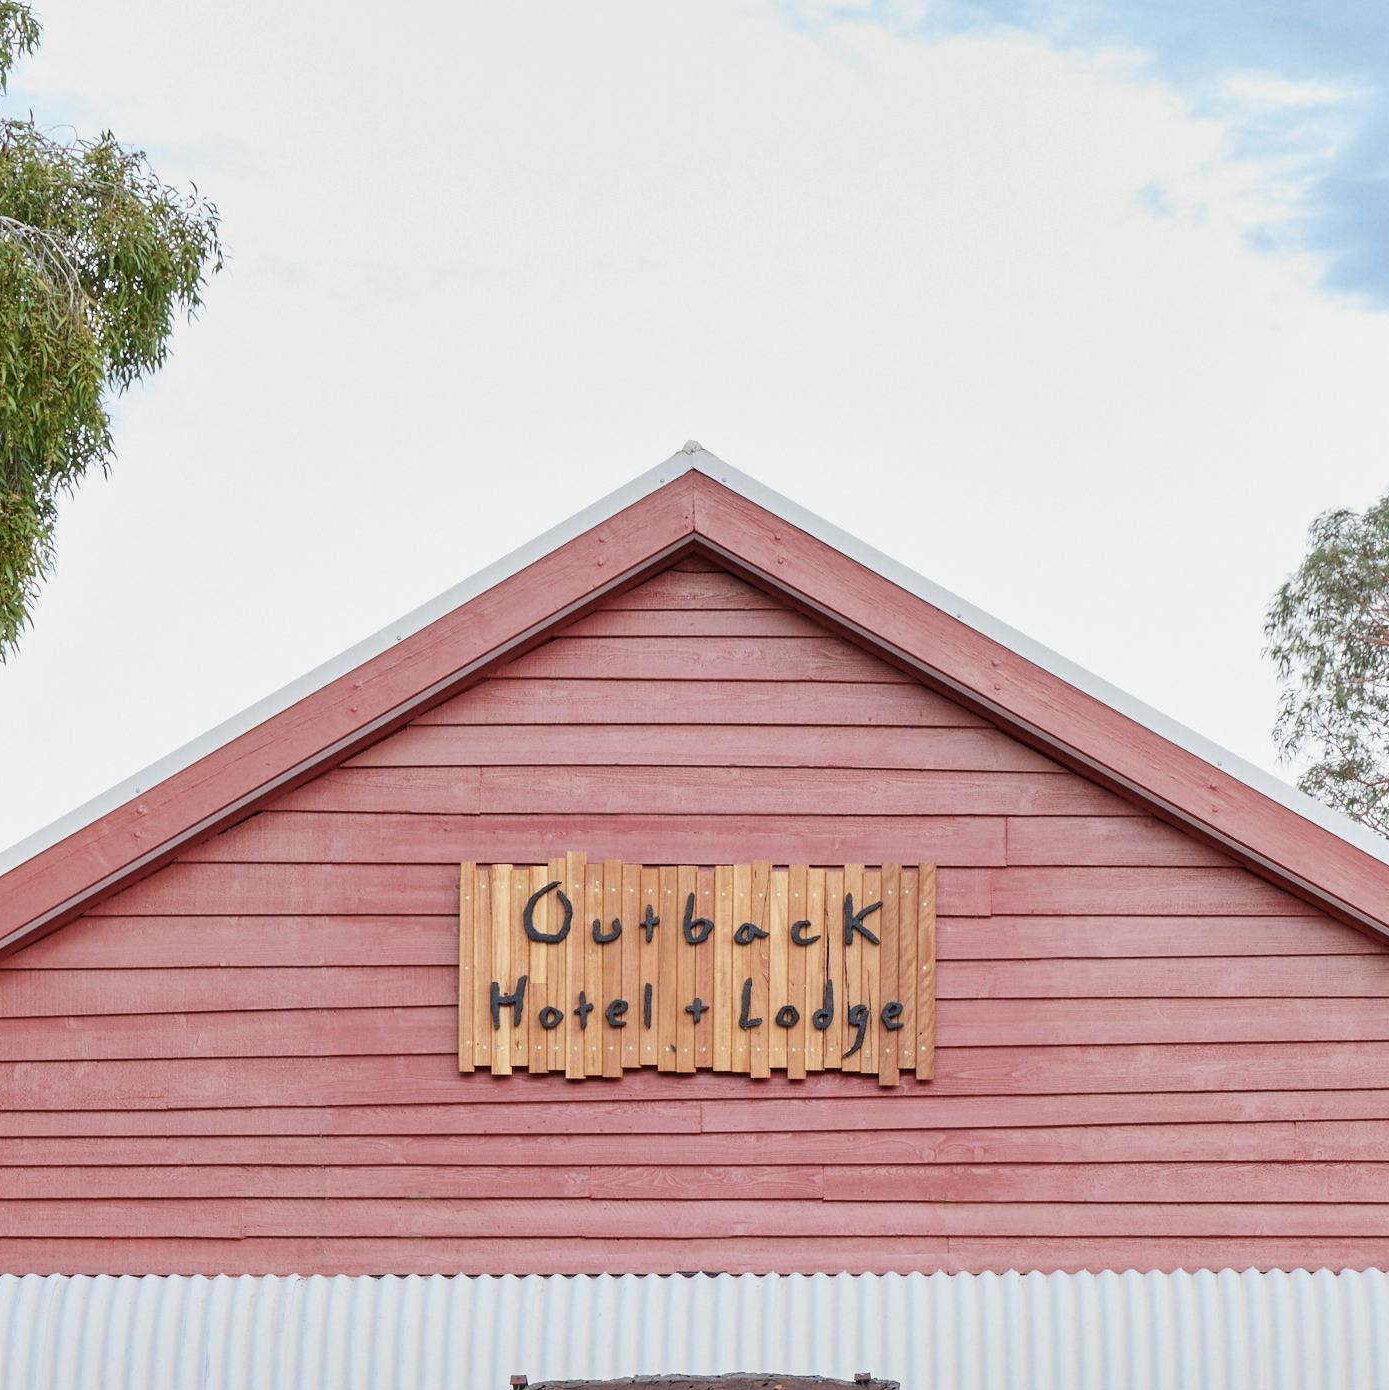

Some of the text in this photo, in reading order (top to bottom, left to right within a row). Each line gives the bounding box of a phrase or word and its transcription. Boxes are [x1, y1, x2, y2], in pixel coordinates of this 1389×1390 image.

[490, 975, 904, 1059] Hotel + Lodge
